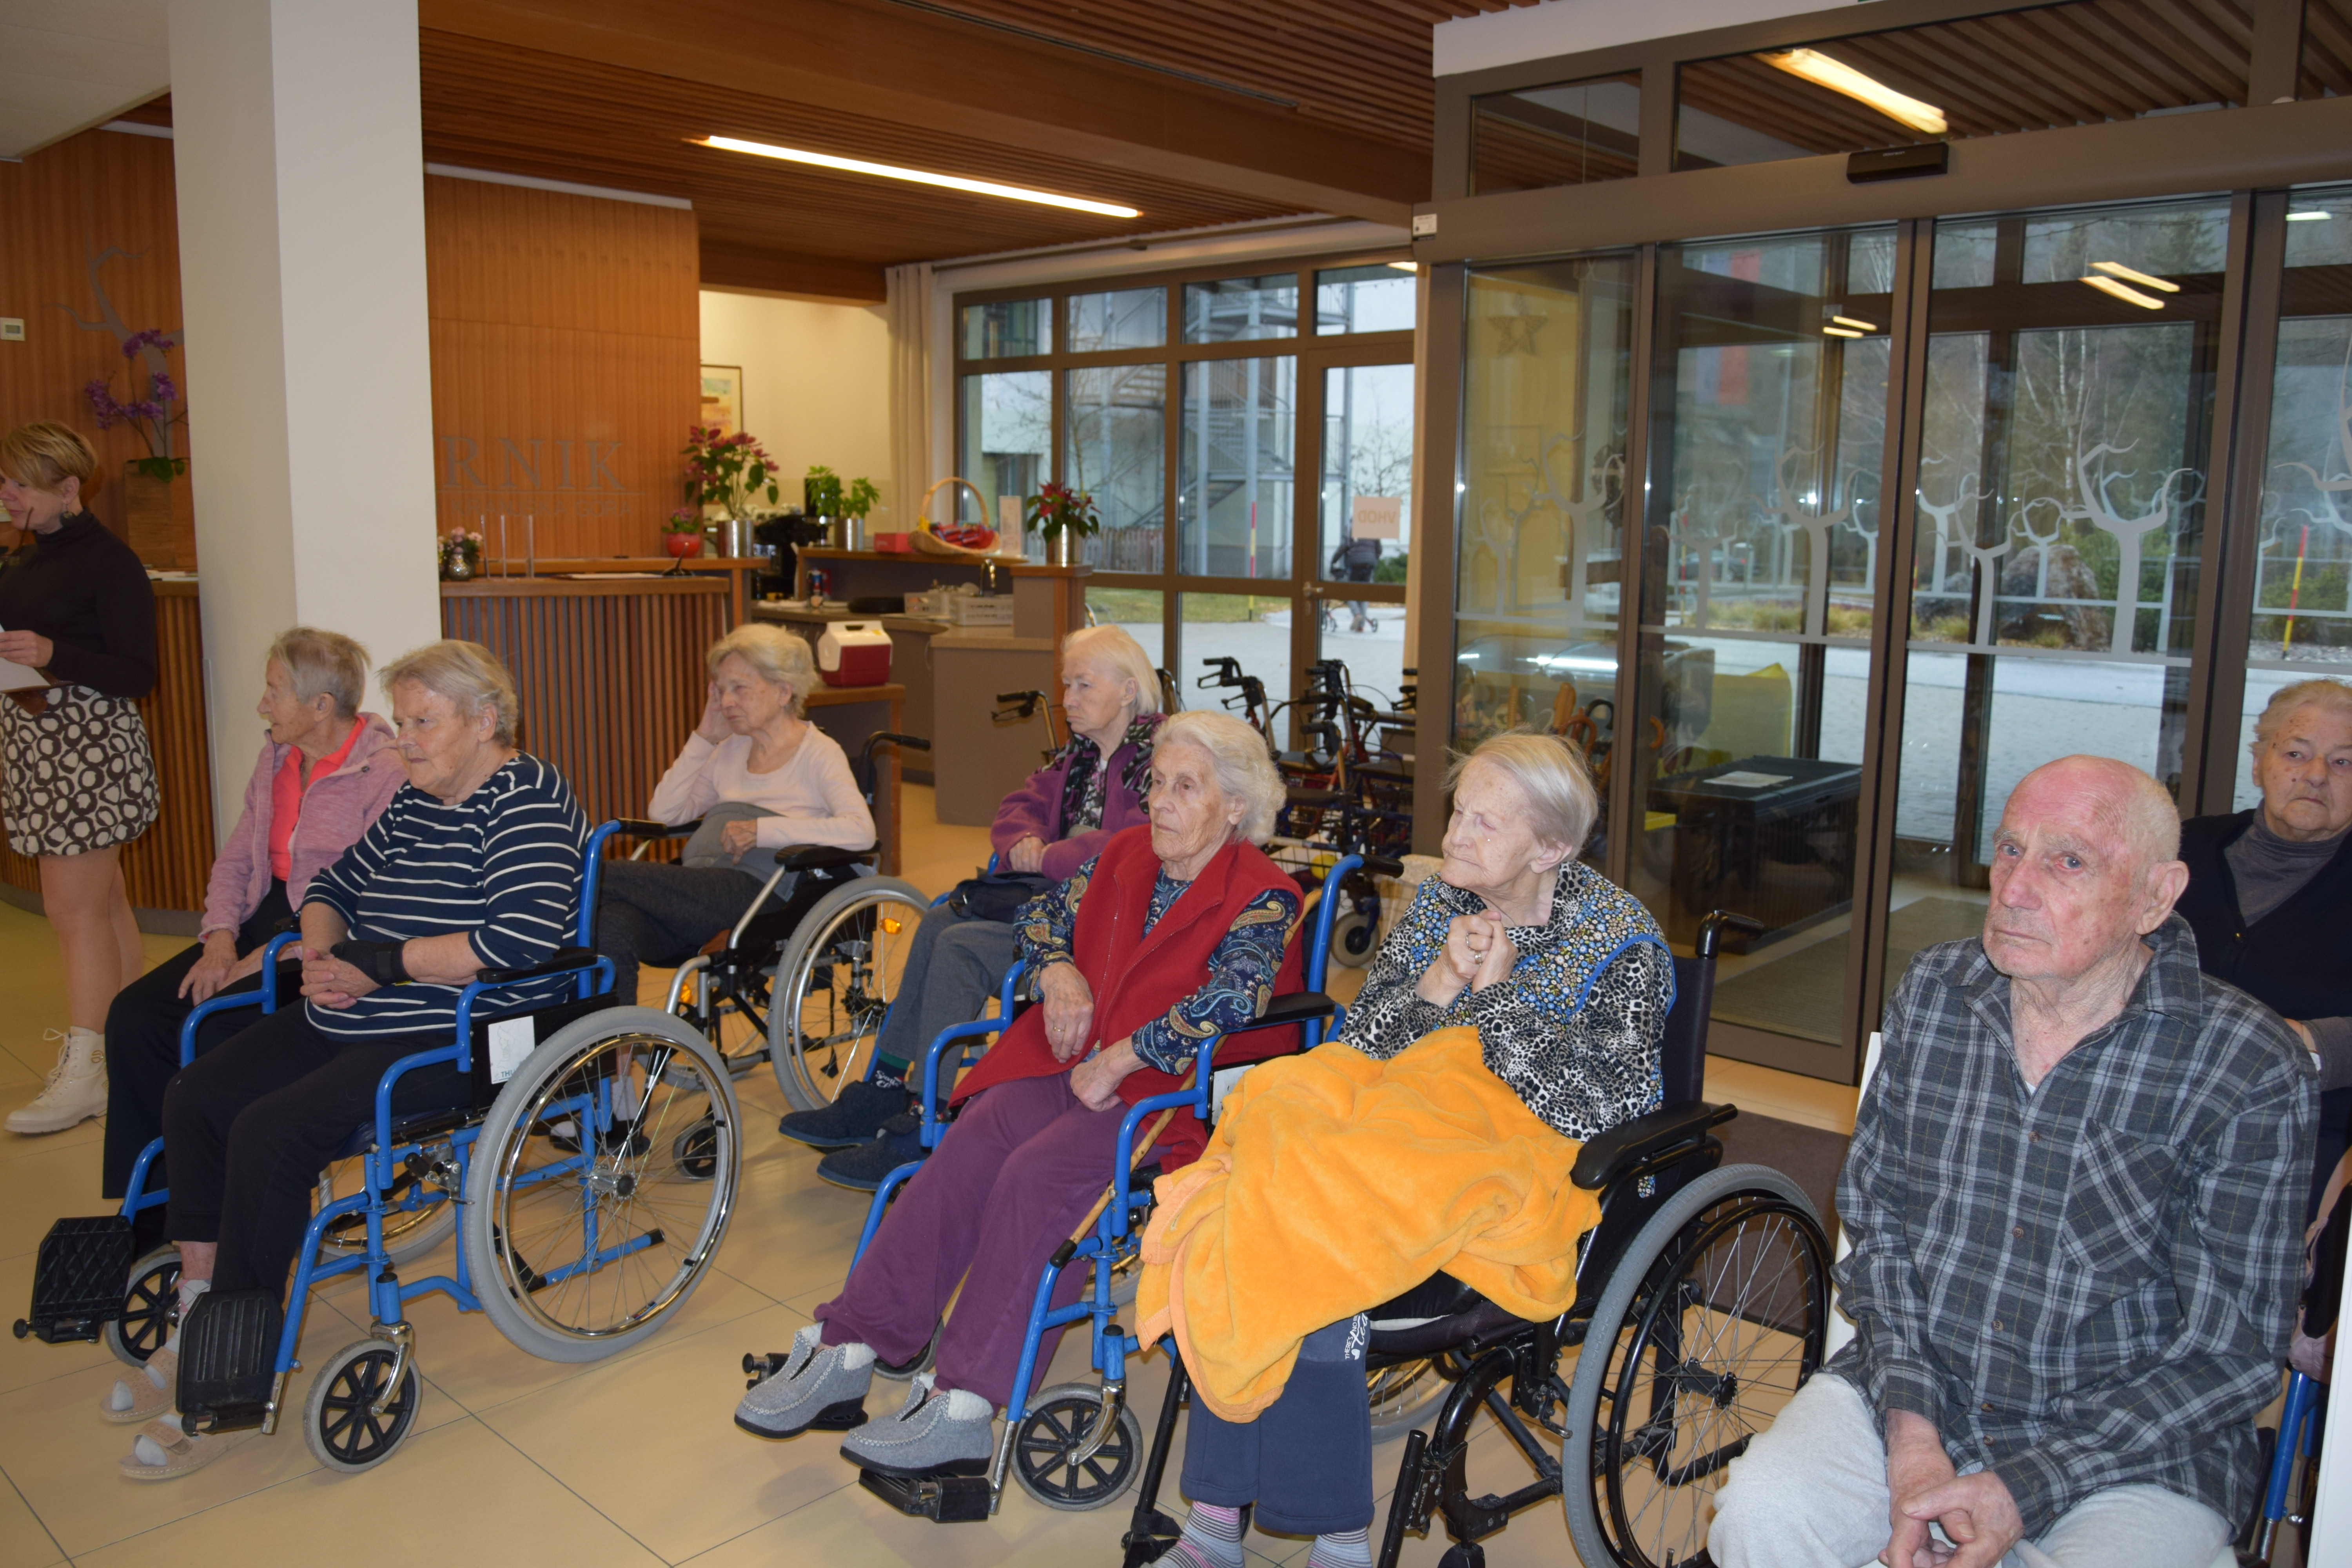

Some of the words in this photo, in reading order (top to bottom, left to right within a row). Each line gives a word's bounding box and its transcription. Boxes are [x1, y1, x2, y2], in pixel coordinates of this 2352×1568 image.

[450, 498, 568, 517] KRANJSKA
[575, 500, 632, 518] GORA
[1344, 1336, 1353, 1359] THERE'S
[1352, 1322, 1357, 1332] NO
